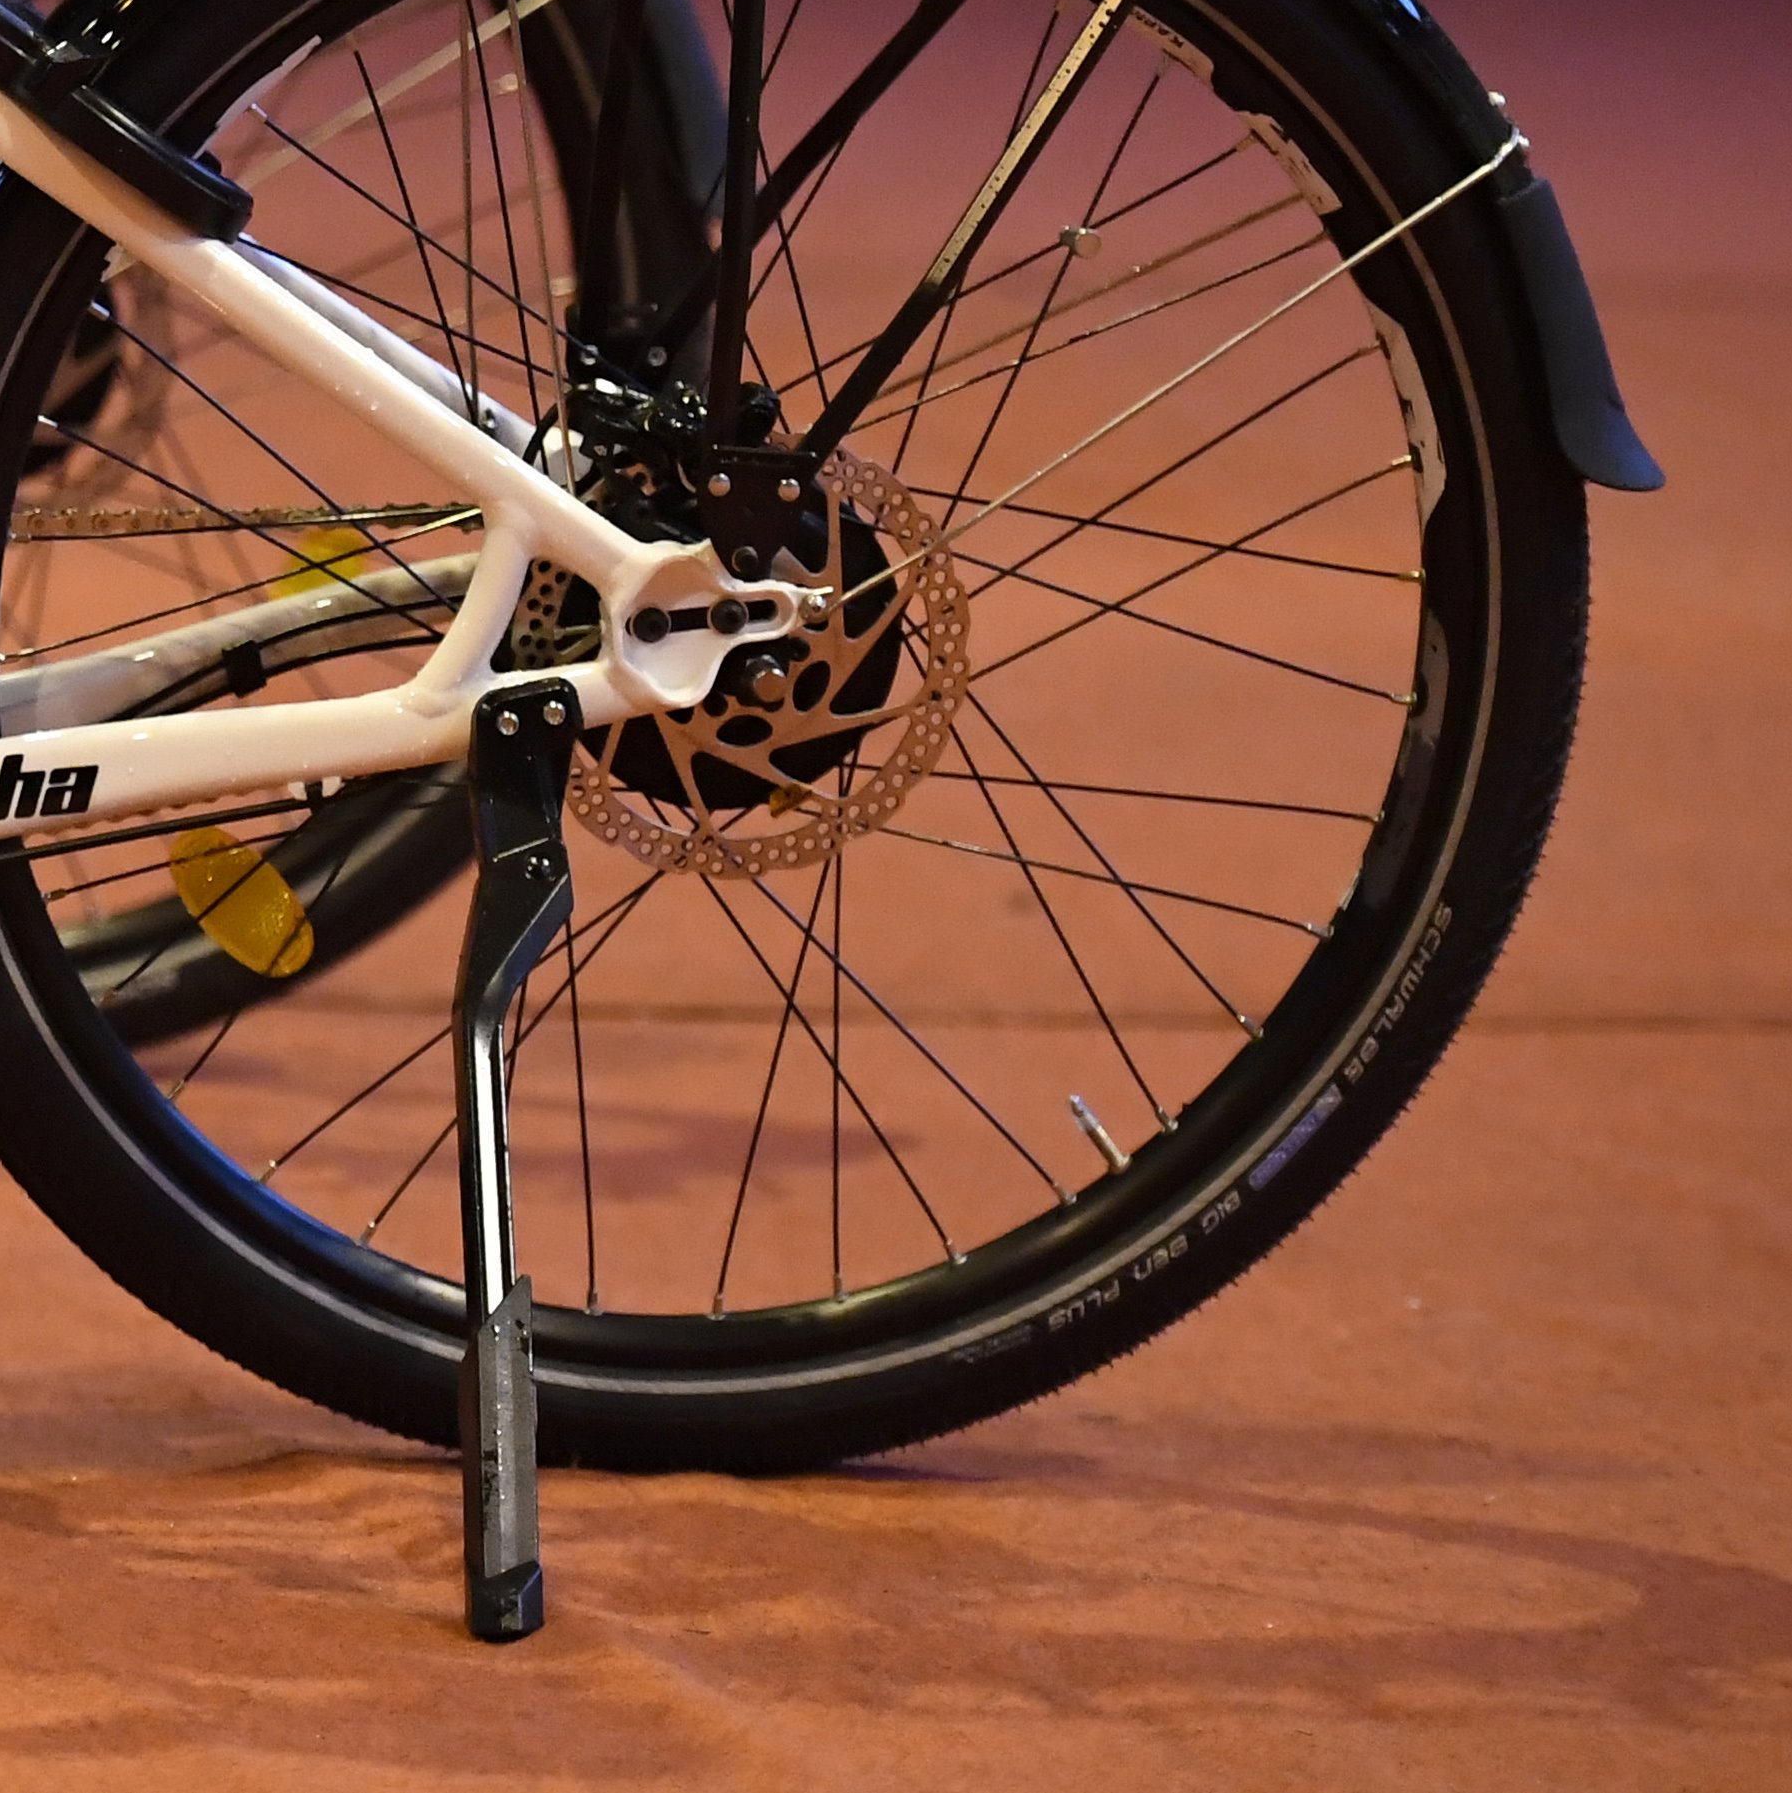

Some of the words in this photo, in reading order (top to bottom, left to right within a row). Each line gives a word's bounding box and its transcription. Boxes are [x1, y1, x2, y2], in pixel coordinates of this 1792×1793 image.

[1343, 901, 1454, 1085] SCHWALBE
[1201, 1189, 1242, 1235] BIG
[1047, 1279, 1121, 1333] PLUS
